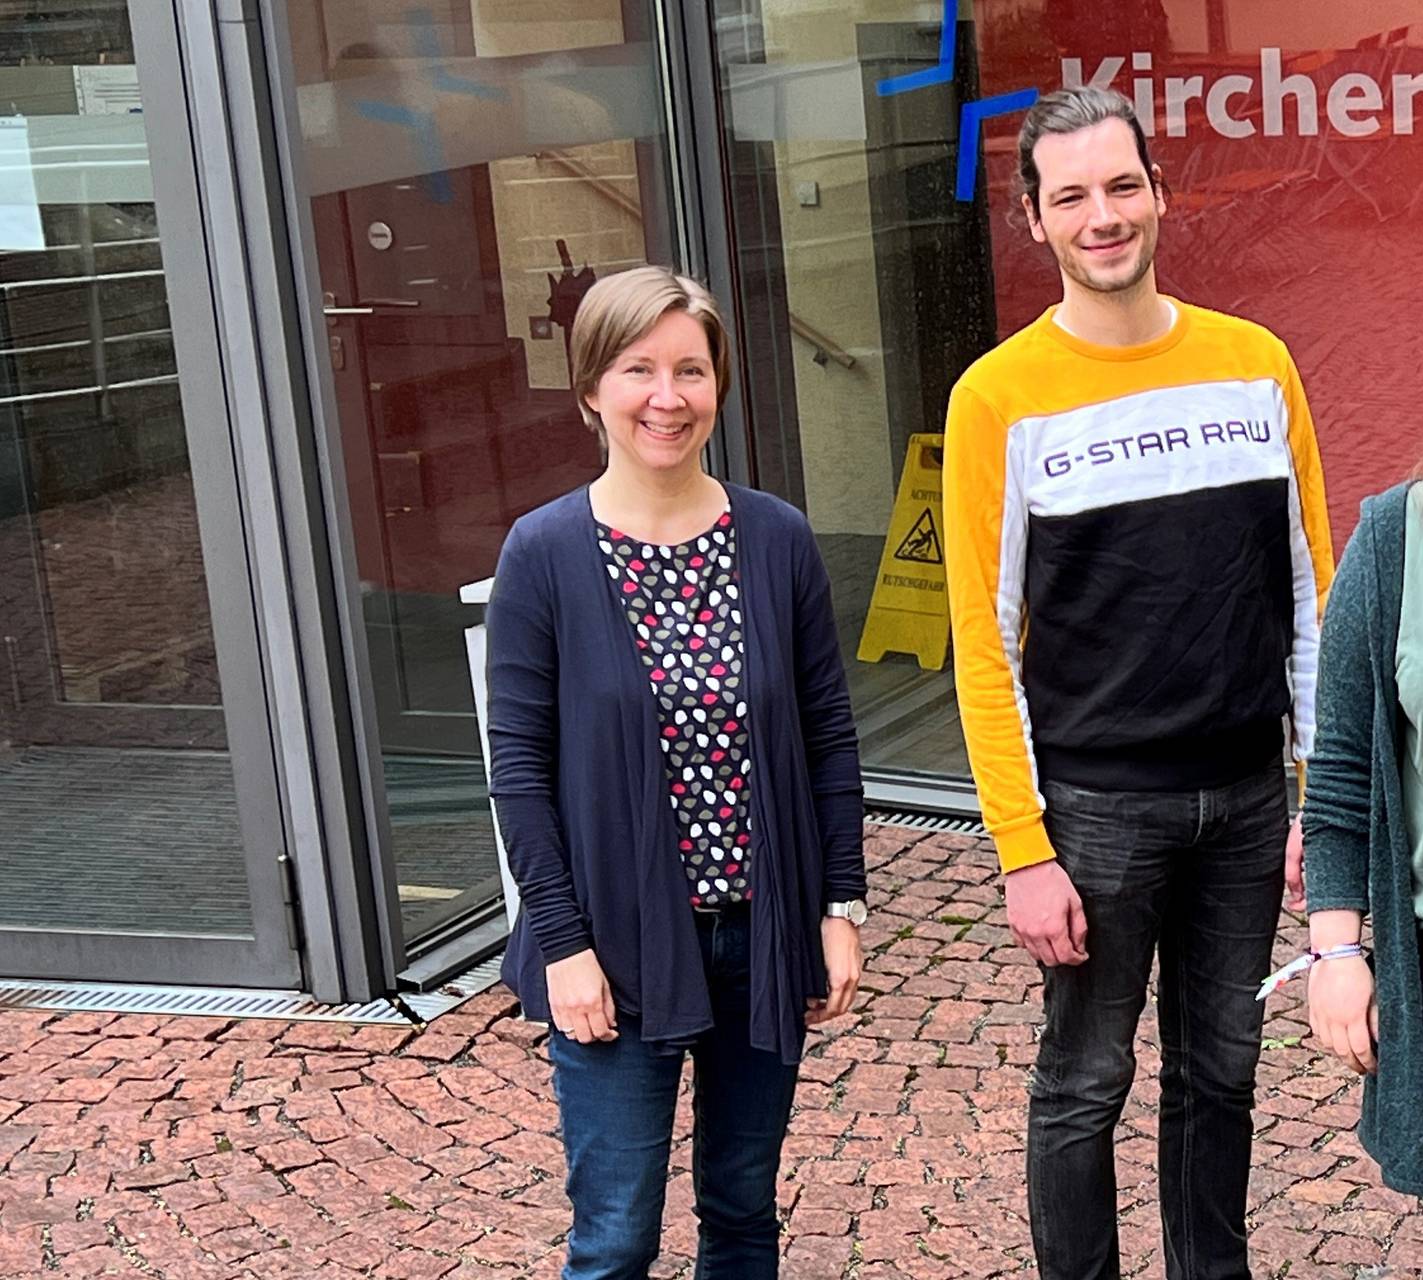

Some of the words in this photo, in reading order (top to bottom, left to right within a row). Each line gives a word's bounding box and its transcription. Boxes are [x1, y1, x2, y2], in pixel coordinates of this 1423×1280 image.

[1043, 427, 1191, 478] G-STAR
[1200, 420, 1271, 445] RAW
[911, 488, 943, 503] ACHTUN
